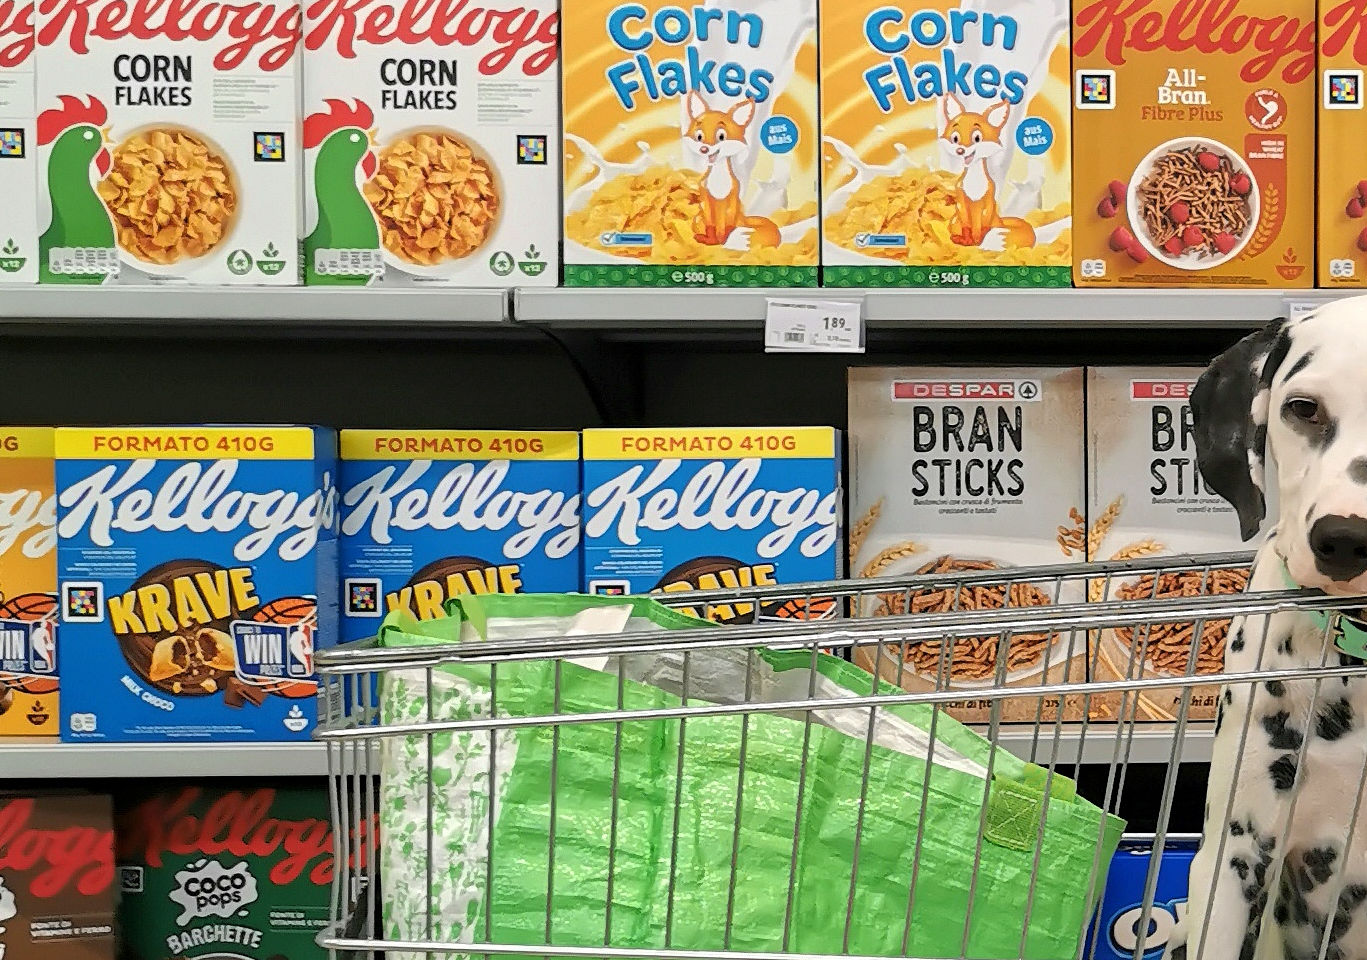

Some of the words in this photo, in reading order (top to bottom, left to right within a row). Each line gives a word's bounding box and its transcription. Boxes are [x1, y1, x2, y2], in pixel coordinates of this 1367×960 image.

[608, 5, 764, 51] Corn
[865, 9, 1018, 54] Corn
[113, 54, 193, 83] CORN
[380, 58, 458, 87] CORN
[607, 45, 775, 109] Flakes
[865, 48, 1029, 111] Flakes
[1165, 68, 1207, 88] All-
[114, 86, 193, 107] FLAKES
[381, 90, 458, 110] FLAKES
[1157, 87, 1208, 105] Bran
[1141, 105, 1184, 121] Fibre
[1188, 105, 1224, 121] Plus
[913, 384, 1014, 397] DESPAR
[913, 405, 1022, 452] BRAN
[94, 436, 209, 452] FORMATO
[215, 436, 274, 452] 410G
[374, 436, 482, 454] FORMATO
[489, 437, 544, 454] 410G
[621, 435, 732, 453] FORMATO
[738, 435, 797, 452] 410G
[911, 458, 1025, 497] STICKS
[108, 566, 261, 635] KRAVE
[243, 633, 282, 664] WIN
[196, 891, 242, 912] pops
[166, 924, 263, 955] BARCHETTE
